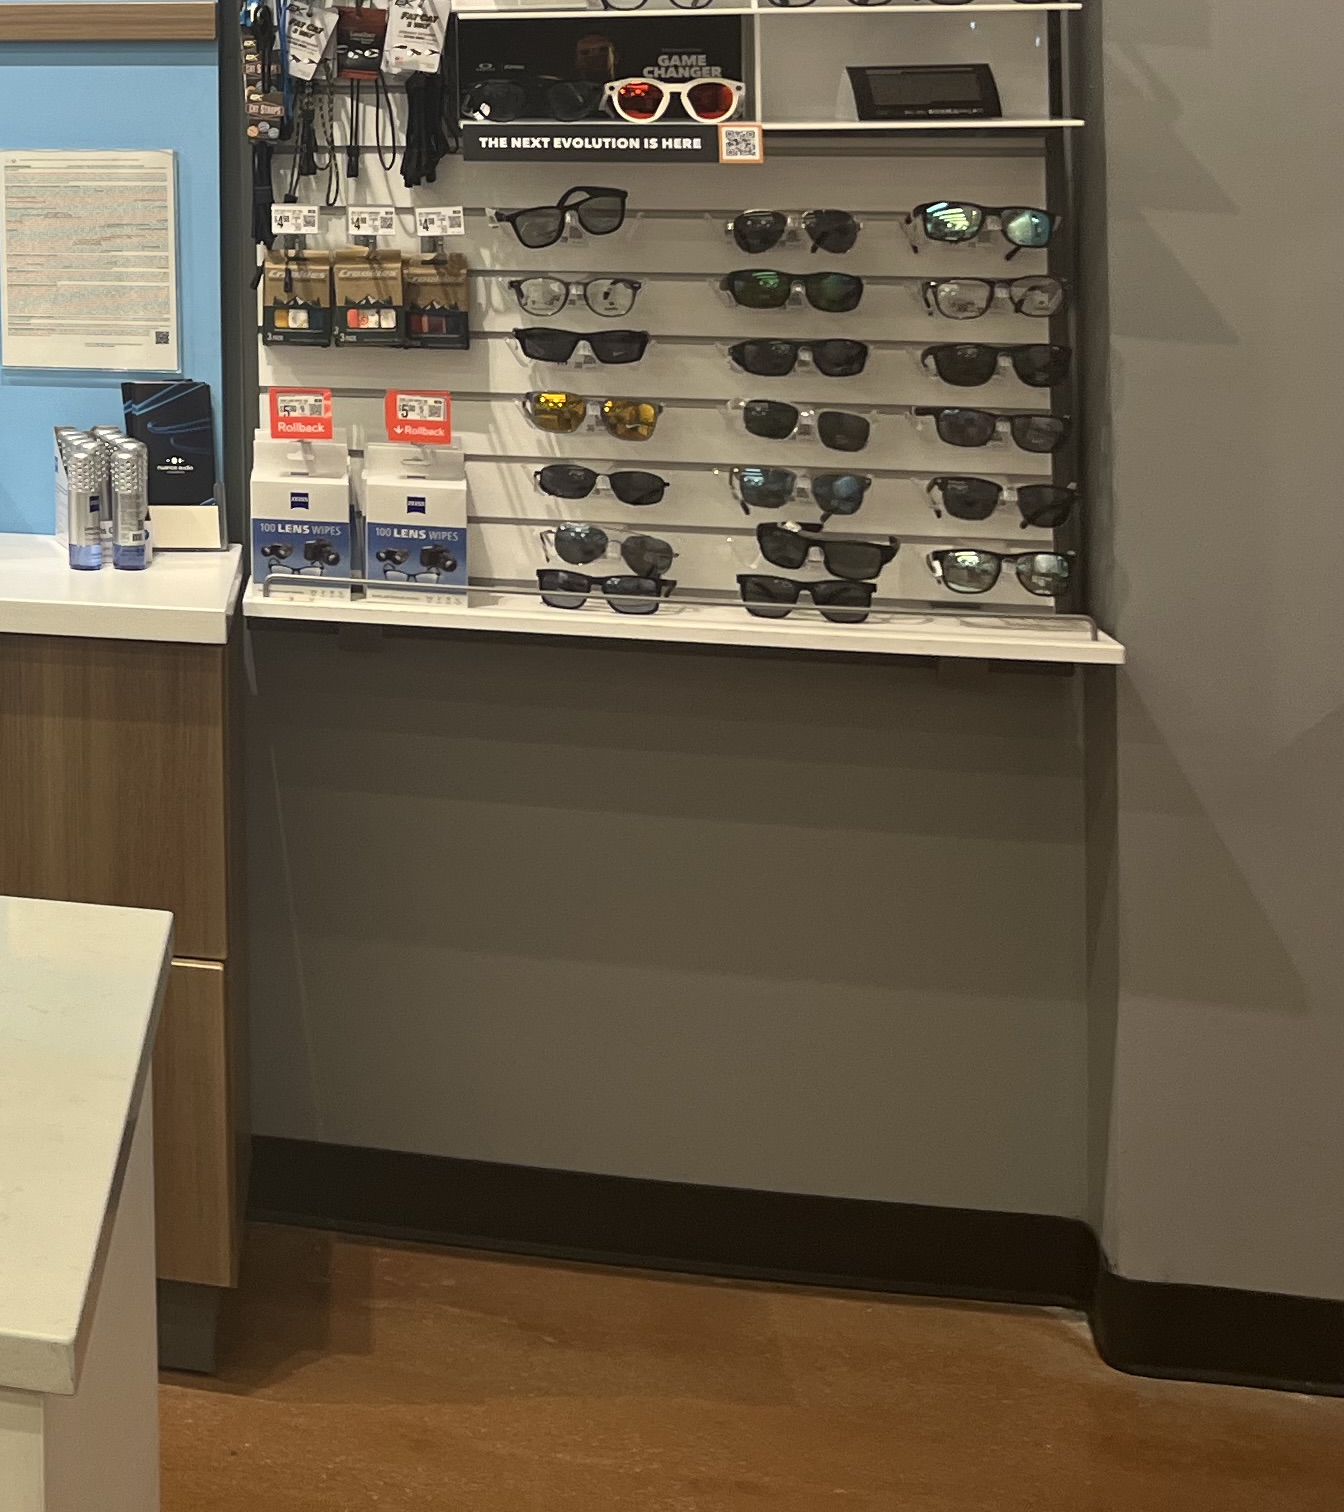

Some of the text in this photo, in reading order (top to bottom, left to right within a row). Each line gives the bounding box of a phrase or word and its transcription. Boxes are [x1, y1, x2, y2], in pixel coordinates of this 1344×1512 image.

[658, 55, 706, 66] GAME
[643, 67, 722, 78] CHANGER
[479, 138, 702, 149] THE NEXT EVOLUTION IS HERE
[278, 422, 325, 433] Rollback
[404, 427, 445, 437] Rollback
[261, 524, 341, 536] 100 LENS WIPES
[376, 528, 458, 541] 100 LENS WIPES
